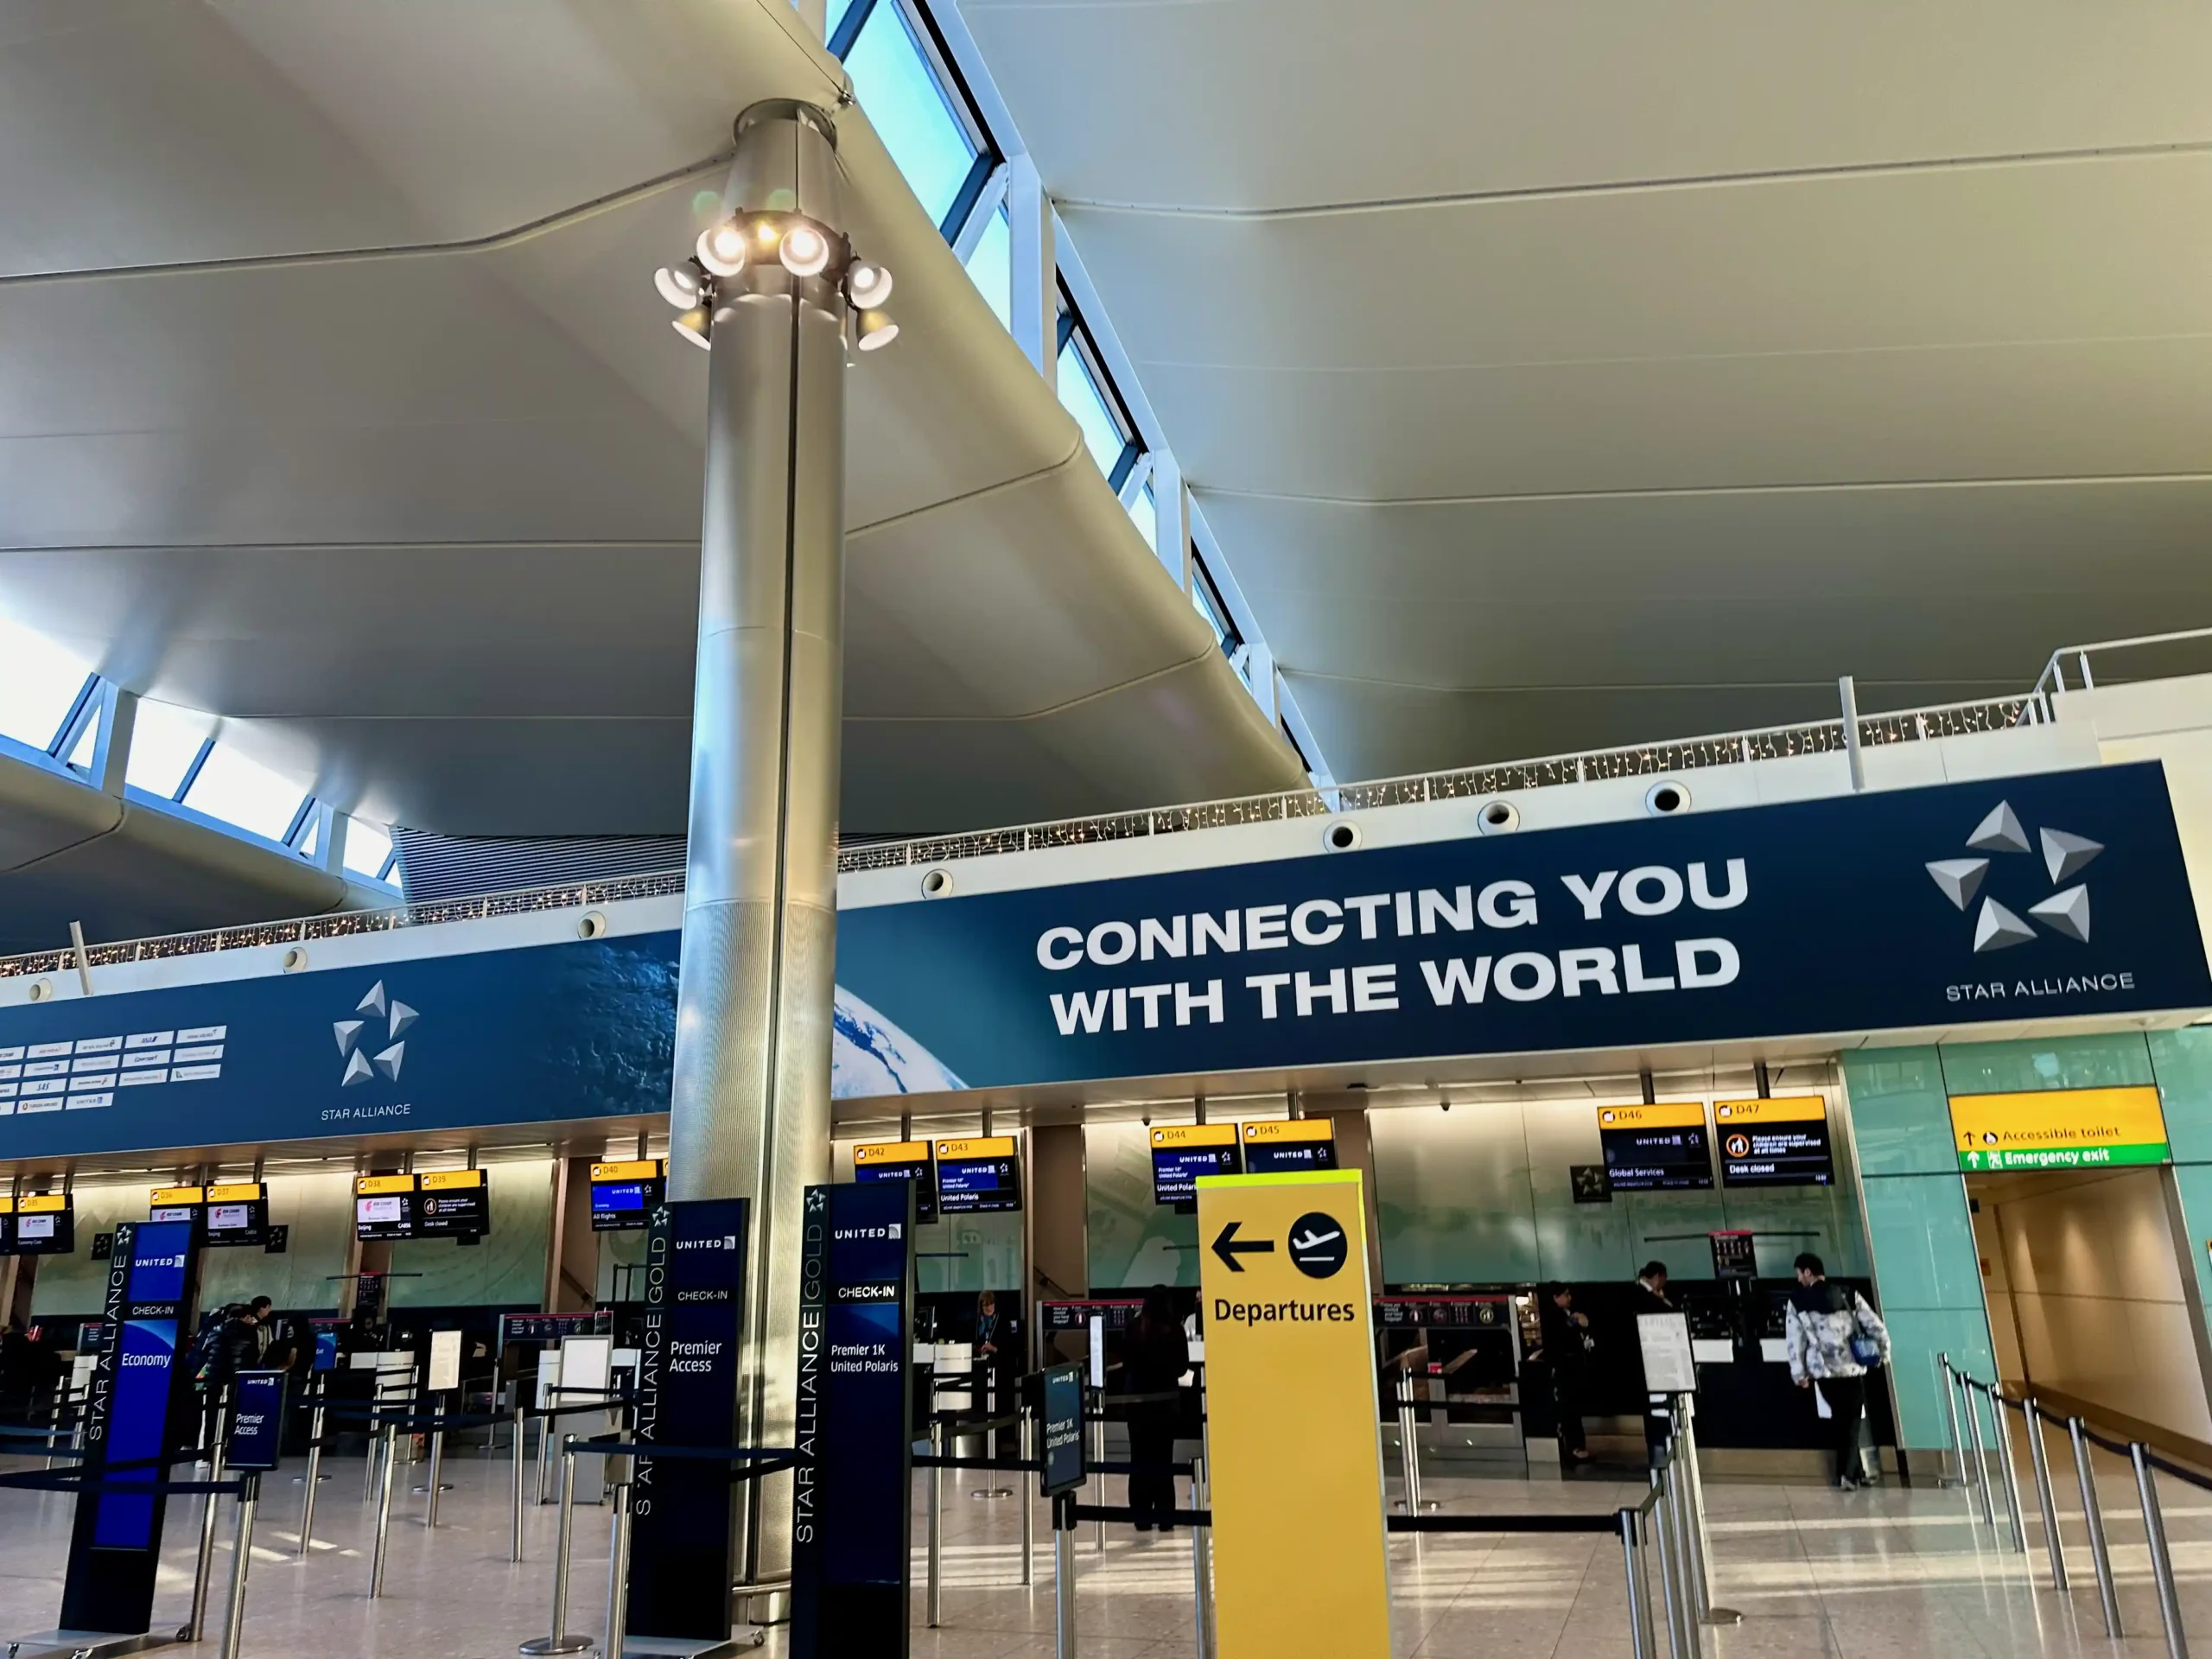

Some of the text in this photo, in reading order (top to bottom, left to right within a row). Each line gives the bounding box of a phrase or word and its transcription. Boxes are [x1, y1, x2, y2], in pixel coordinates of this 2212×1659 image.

[1036, 858, 1749, 971] CONNECTING YOU
[1049, 937, 1741, 1036] WITH THE WORLD
[1947, 972, 2135, 1001] STAR ALLIANCE
[321, 1103, 411, 1121] STAR ALLIANCE
[1618, 1110, 1643, 1121] D46
[1736, 1105, 1759, 1116] D47
[1167, 1131, 1186, 1140] D44
[1260, 1126, 1280, 1135] D45
[2003, 1127, 2121, 1141] Accessible toilet
[951, 1143, 969, 1152] D43
[1636, 1137, 1670, 1146] UNITED
[868, 1147, 885, 1156] D42
[2005, 1148, 2110, 1166] Emergency exit
[1609, 1167, 1664, 1177] Global Services
[1729, 1163, 1775, 1173] Desk closed
[432, 1175, 447, 1184] D39
[1157, 1183, 1178, 1192] United
[960, 1192, 979, 1201] Polaris
[834, 1228, 887, 1240] UNITED
[676, 1239, 722, 1250] UNITED
[135, 1257, 174, 1268] UNITED
[648, 1236, 666, 1304] GOLD
[677, 1290, 728, 1301] CHECK-IN
[838, 1286, 895, 1299] CHECK-IN
[132, 1306, 175, 1316] CHECK-IN
[1214, 1299, 1355, 1328] Departures
[89, 1255, 127, 1441] STAR ALLIANCE
[670, 1339, 722, 1356] Premier
[830, 1343, 886, 1357] Premier 1K
[121, 1352, 172, 1369] Economy
[669, 1357, 712, 1373] Access
[830, 1359, 899, 1373] United Polaris
[640, 1313, 662, 1440] ALLIANCE
[797, 1224, 823, 1543] STAR ALLIANCE GOLD
[236, 1412, 264, 1424] Premier
[234, 1424, 258, 1435] Access
[1046, 1420, 1066, 1434] Premier
[1046, 1429, 1080, 1449] United Polaris
